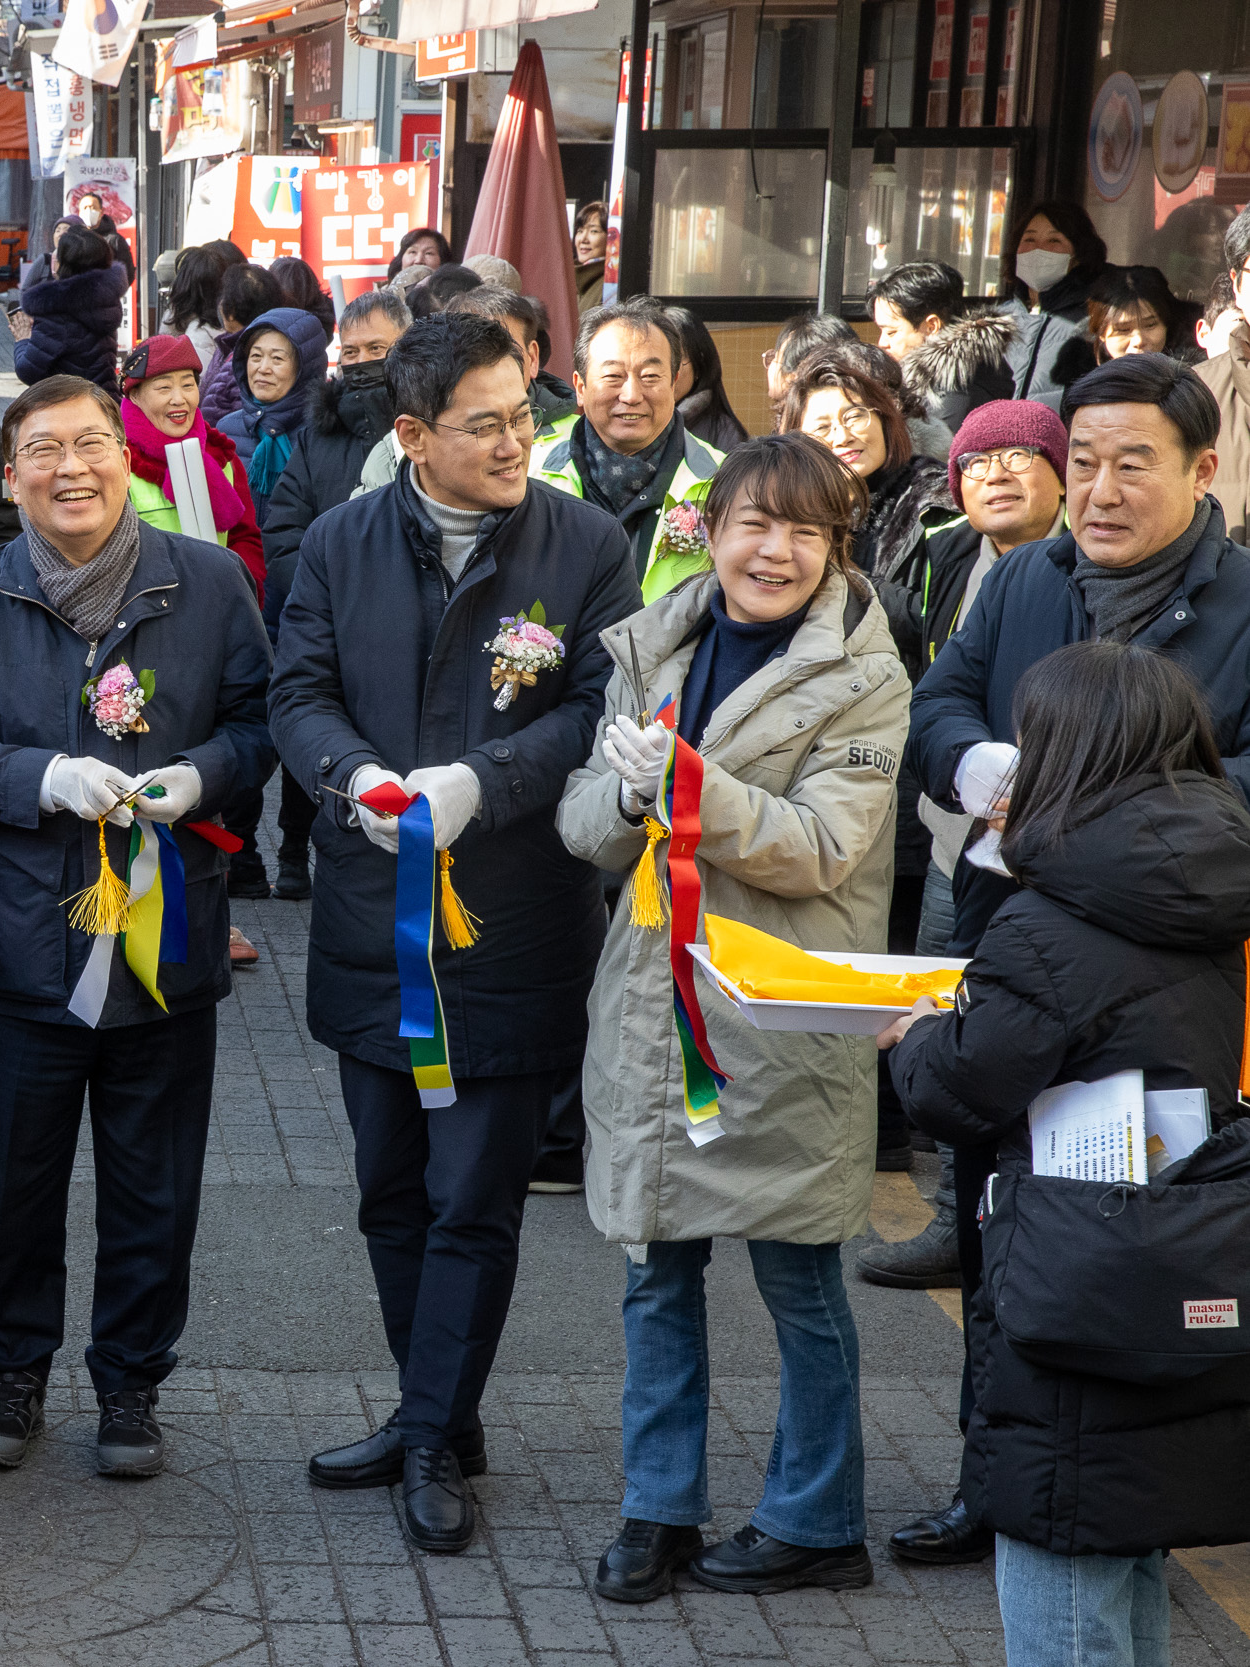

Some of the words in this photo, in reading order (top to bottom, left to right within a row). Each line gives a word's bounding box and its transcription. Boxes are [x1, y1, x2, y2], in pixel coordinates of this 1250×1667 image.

[849, 739, 877, 749] SPORTS
[878, 743, 897, 760] LEADER
[848, 746, 896, 780] SEOUL
[1188, 1304, 1234, 1313] masma
[1189, 1314, 1226, 1324] rulez.
